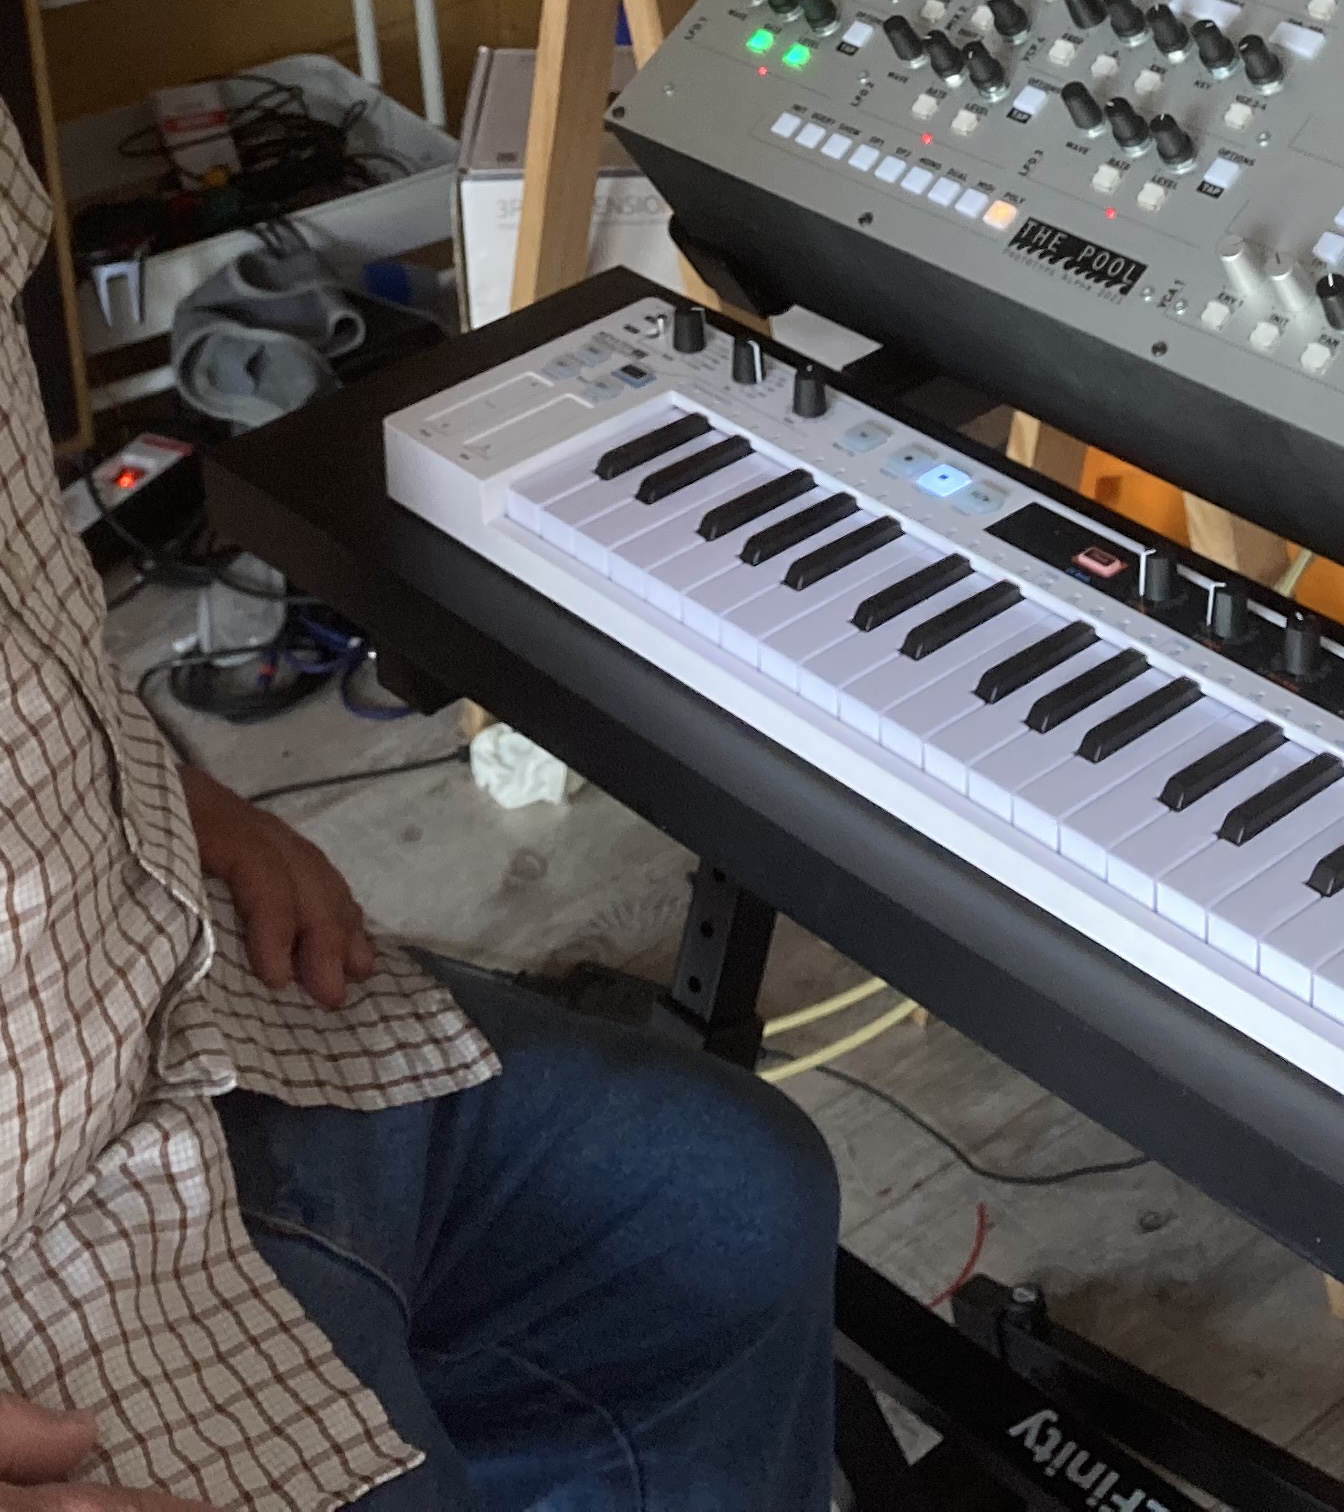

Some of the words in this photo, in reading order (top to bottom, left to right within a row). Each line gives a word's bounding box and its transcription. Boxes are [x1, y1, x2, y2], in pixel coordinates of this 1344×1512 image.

[1065, 141, 1090, 156] WAVE
[1218, 147, 1256, 167] OPTIONS
[947, 168, 968, 182] DUAL
[1151, 174, 1178, 190] LEVEL
[1199, 180, 1223, 197] TAP
[1003, 192, 1025, 205] POLY
[1020, 221, 1067, 251] THE
[1076, 245, 1139, 285] POOL
[1218, 291, 1237, 306] ENV
[1269, 314, 1290, 326] INIT
[1320, 334, 1341, 348] PAN
